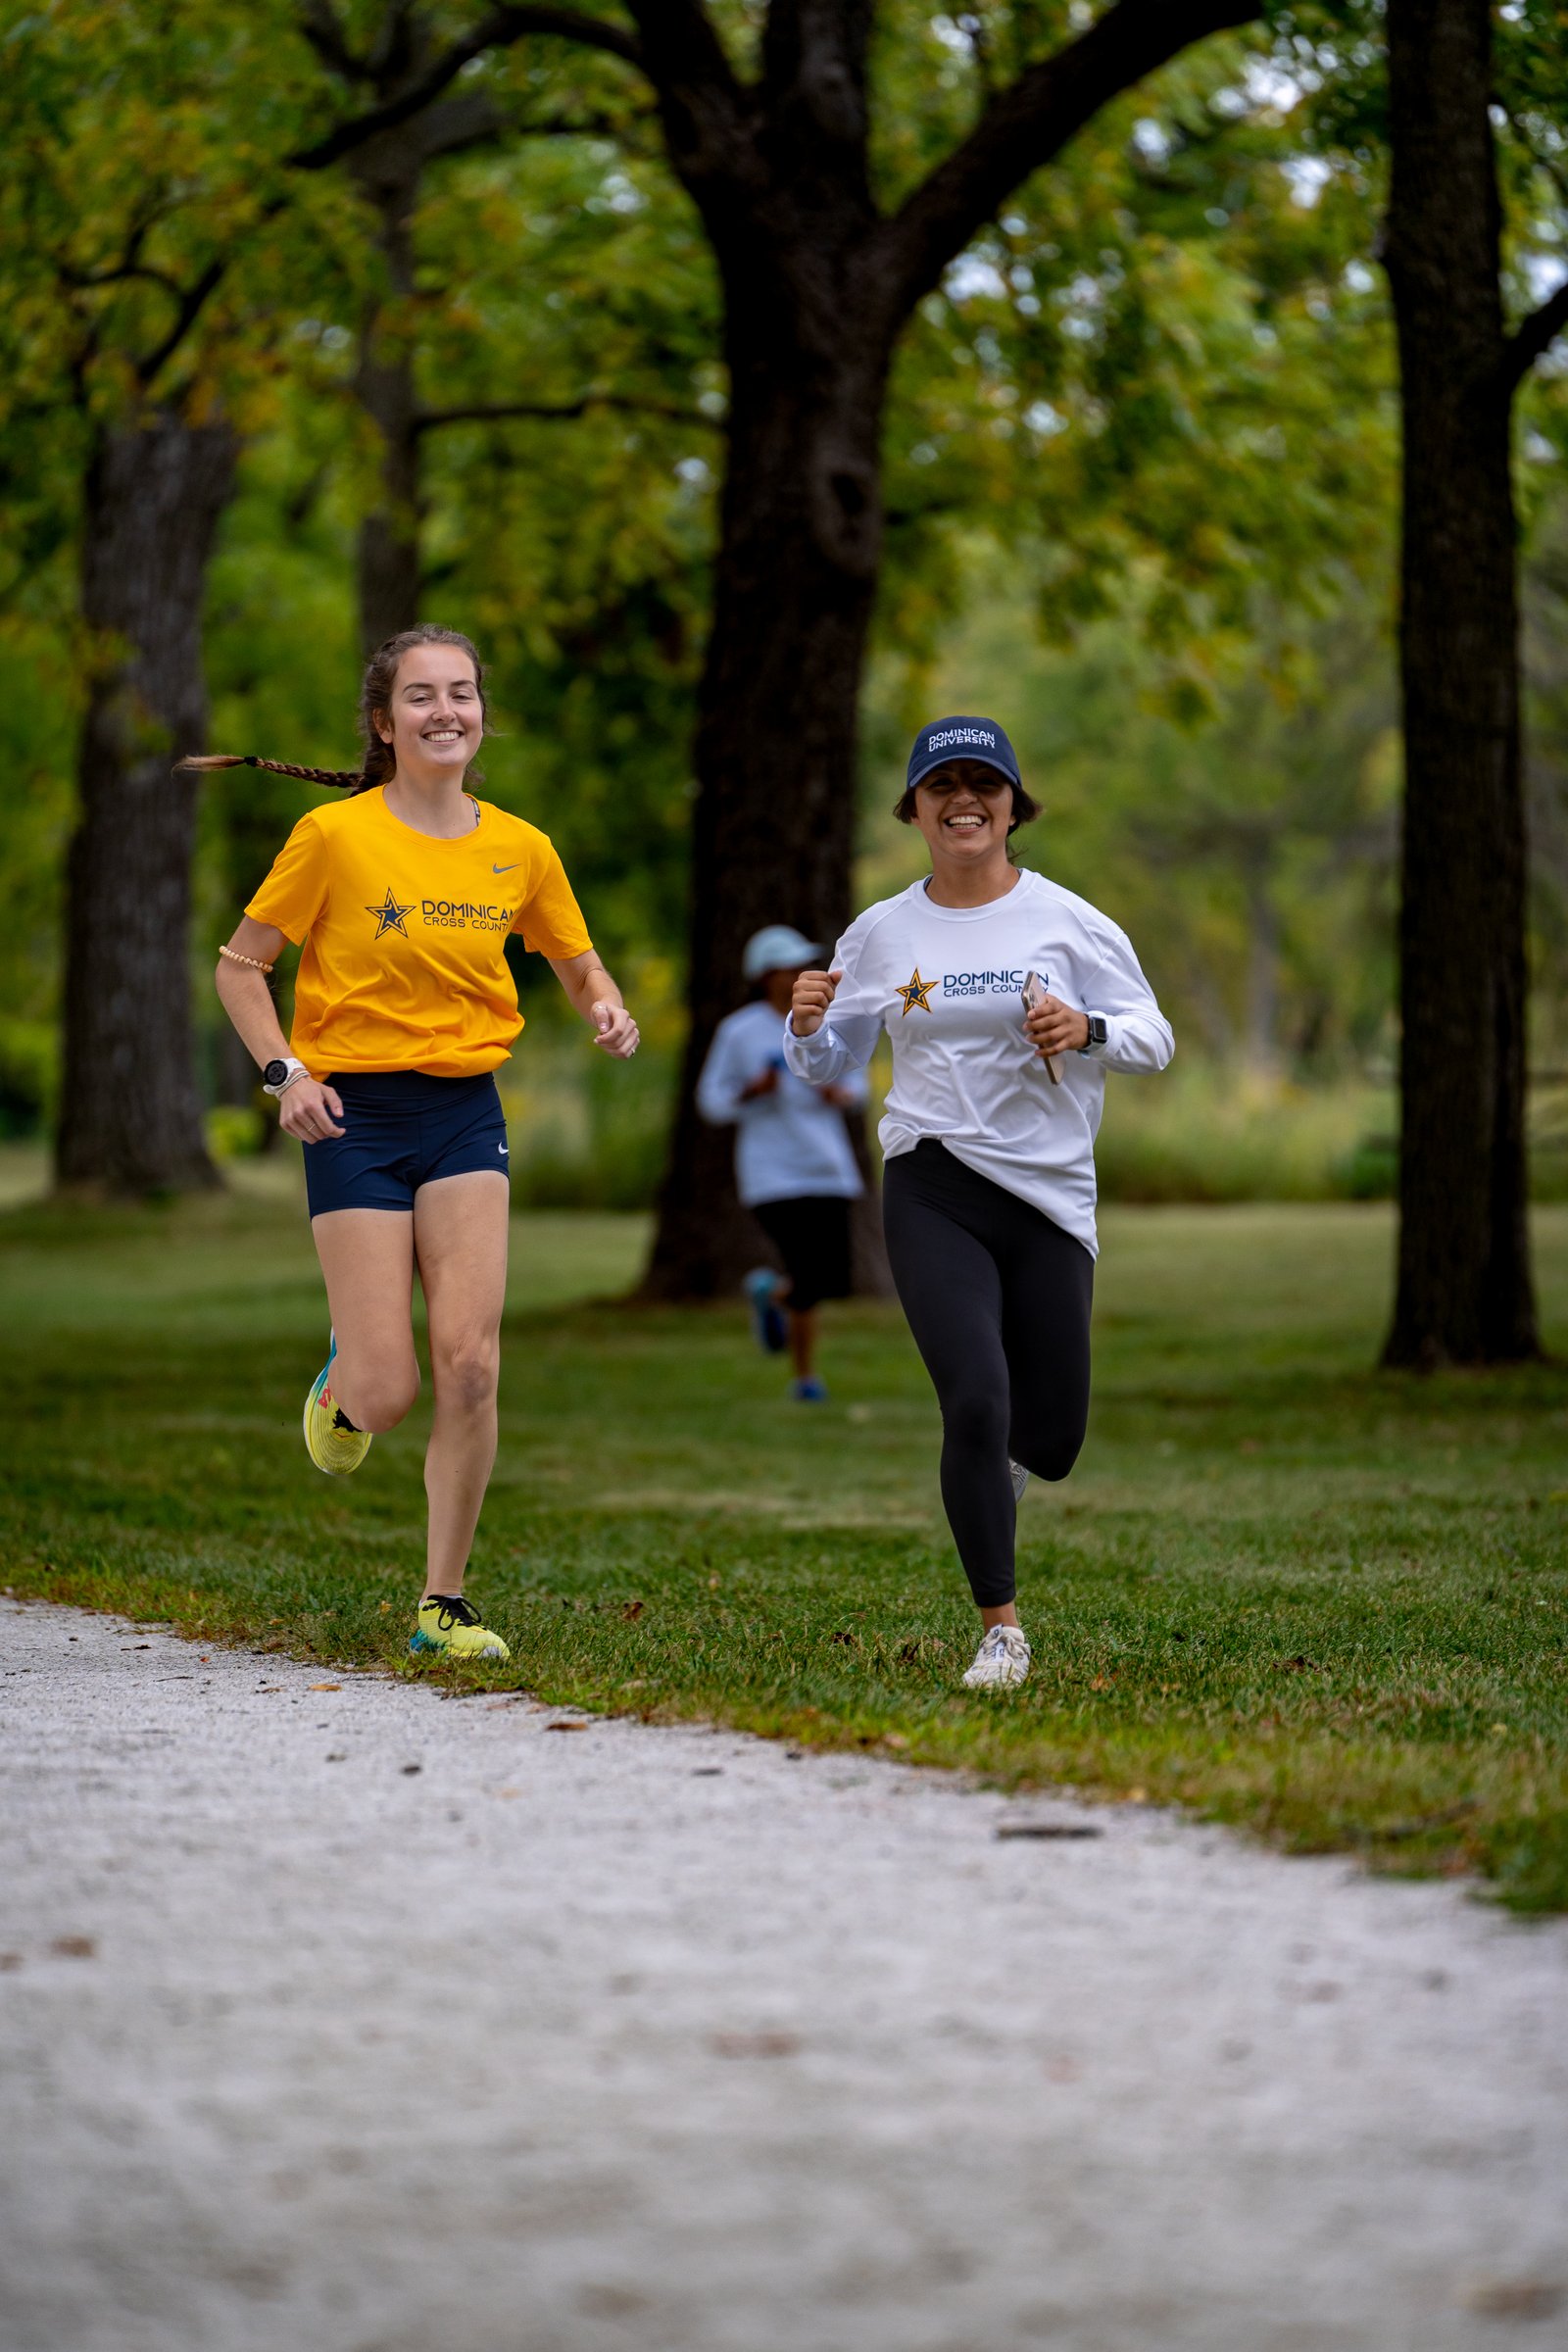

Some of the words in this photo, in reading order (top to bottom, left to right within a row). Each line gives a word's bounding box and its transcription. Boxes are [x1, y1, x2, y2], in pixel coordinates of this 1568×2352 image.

[928, 728, 995, 745] DOMINICAN
[928, 736, 996, 752] UNIVERSITY
[423, 916, 466, 928] CROSS
[471, 919, 509, 933] COUNT
[944, 970, 1049, 989] DOMINICN
[944, 984, 986, 998] CROSS
[992, 984, 1049, 995] COUNY
